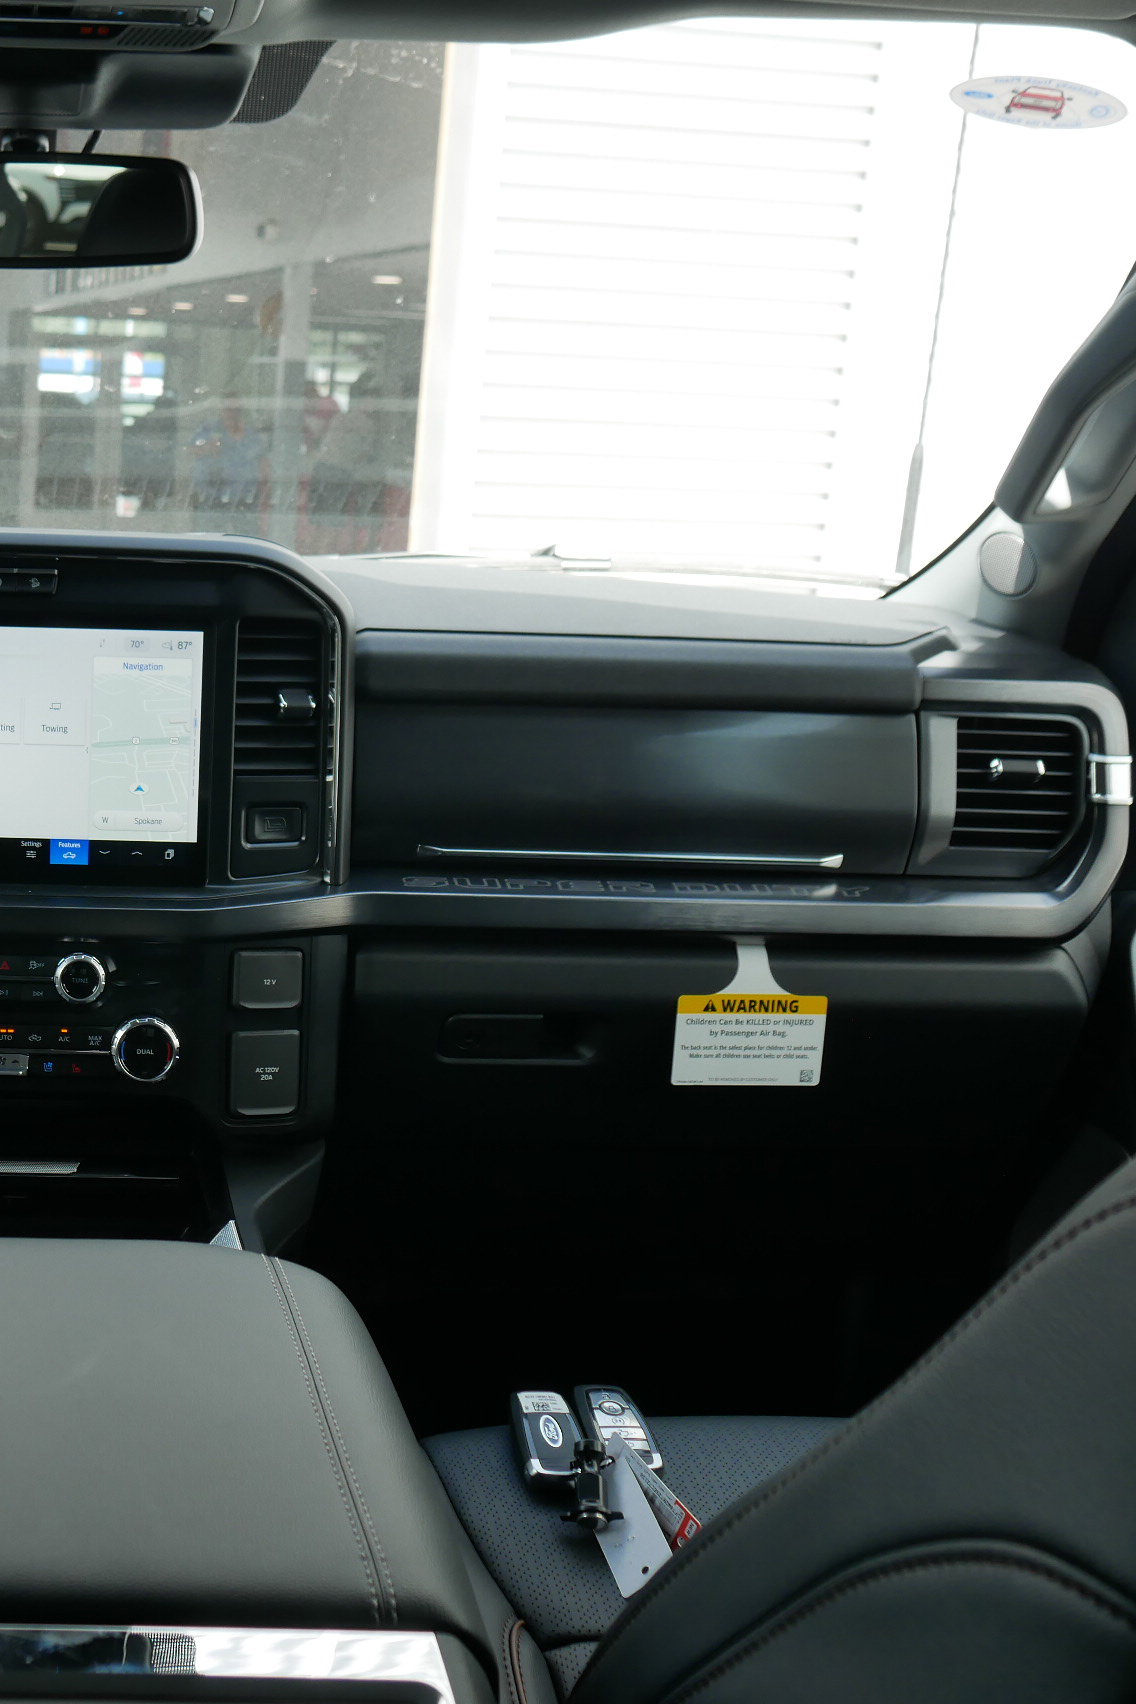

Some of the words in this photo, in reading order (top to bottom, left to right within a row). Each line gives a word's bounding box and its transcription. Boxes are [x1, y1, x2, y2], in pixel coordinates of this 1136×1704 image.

[130, 640, 145, 648] 70°
[177, 641, 192, 650] 87°
[123, 662, 163, 671] Navigation
[41, 724, 69, 734] Towing
[101, 816, 109, 824] W
[134, 817, 163, 826] Spokane
[20, 840, 43, 848] Settings
[401, 875, 657, 893] SUPER
[721, 999, 800, 1013] WARNING
[685, 1018, 717, 1026] Children
[719, 1018, 733, 1026] Can
[735, 1018, 745, 1026] Be
[746, 1018, 772, 1026] KILLED
[782, 1018, 815, 1027] INJURED
[709, 1029, 719, 1037] by
[720, 1029, 758, 1038] Passenger
[759, 1029, 771, 1037] Air
[58, 1035, 70, 1043] A/C
